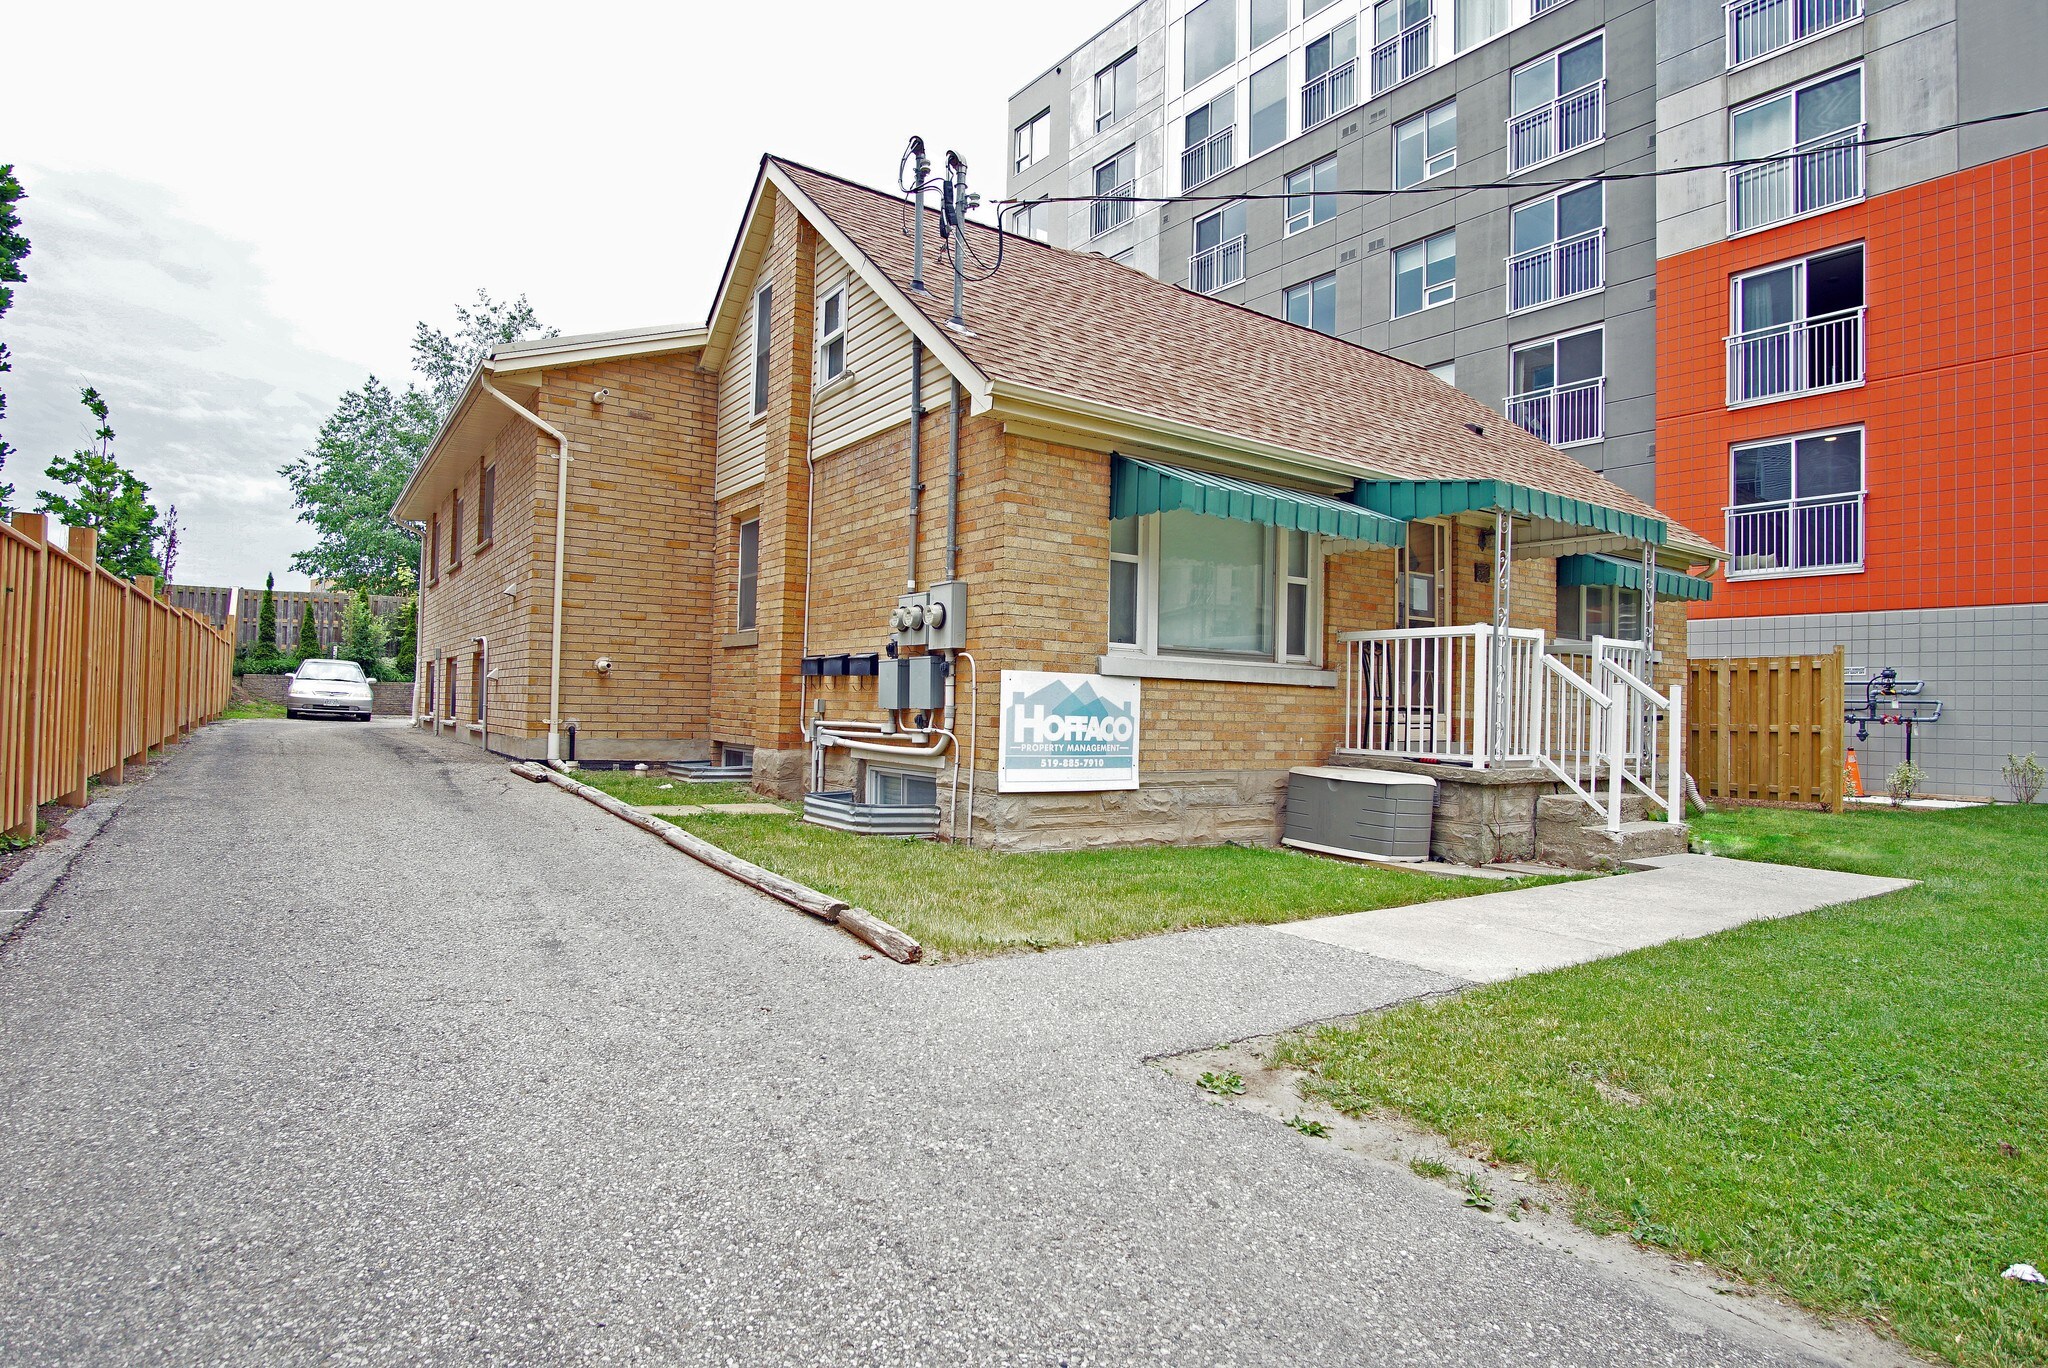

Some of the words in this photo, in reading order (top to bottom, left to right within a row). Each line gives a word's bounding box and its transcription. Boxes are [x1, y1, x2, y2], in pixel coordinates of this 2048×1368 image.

[1014, 704, 1132, 742] HOFFACO
[1021, 744, 1064, 752] PROPERTY
[1066, 744, 1120, 752] MANAGEMENT
[1040, 758, 1104, 768] 519-885-7910
